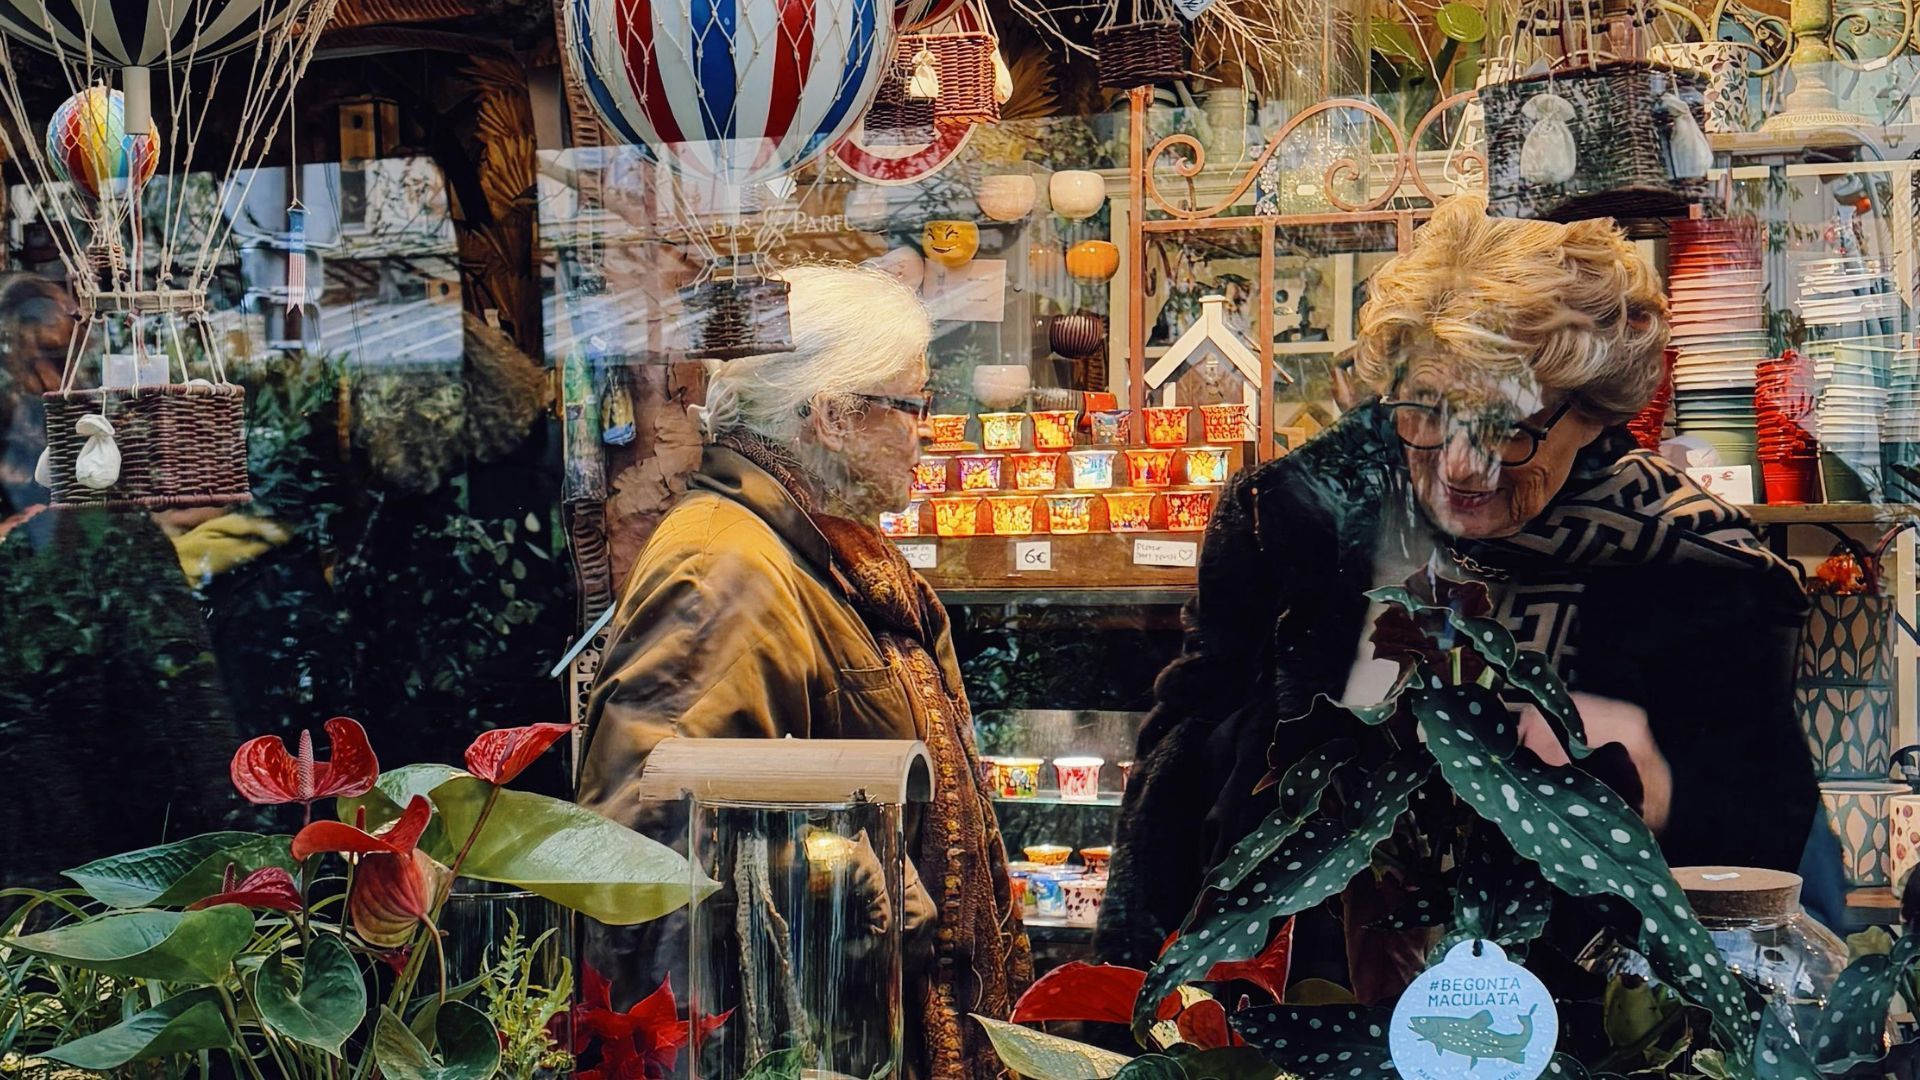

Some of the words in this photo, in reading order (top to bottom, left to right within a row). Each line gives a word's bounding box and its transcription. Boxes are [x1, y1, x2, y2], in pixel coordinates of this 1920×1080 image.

[1023, 548, 1047, 564] 6€
[1429, 976, 1521, 992] #BEGONIA
[1428, 992, 1520, 1007] MACULATA
